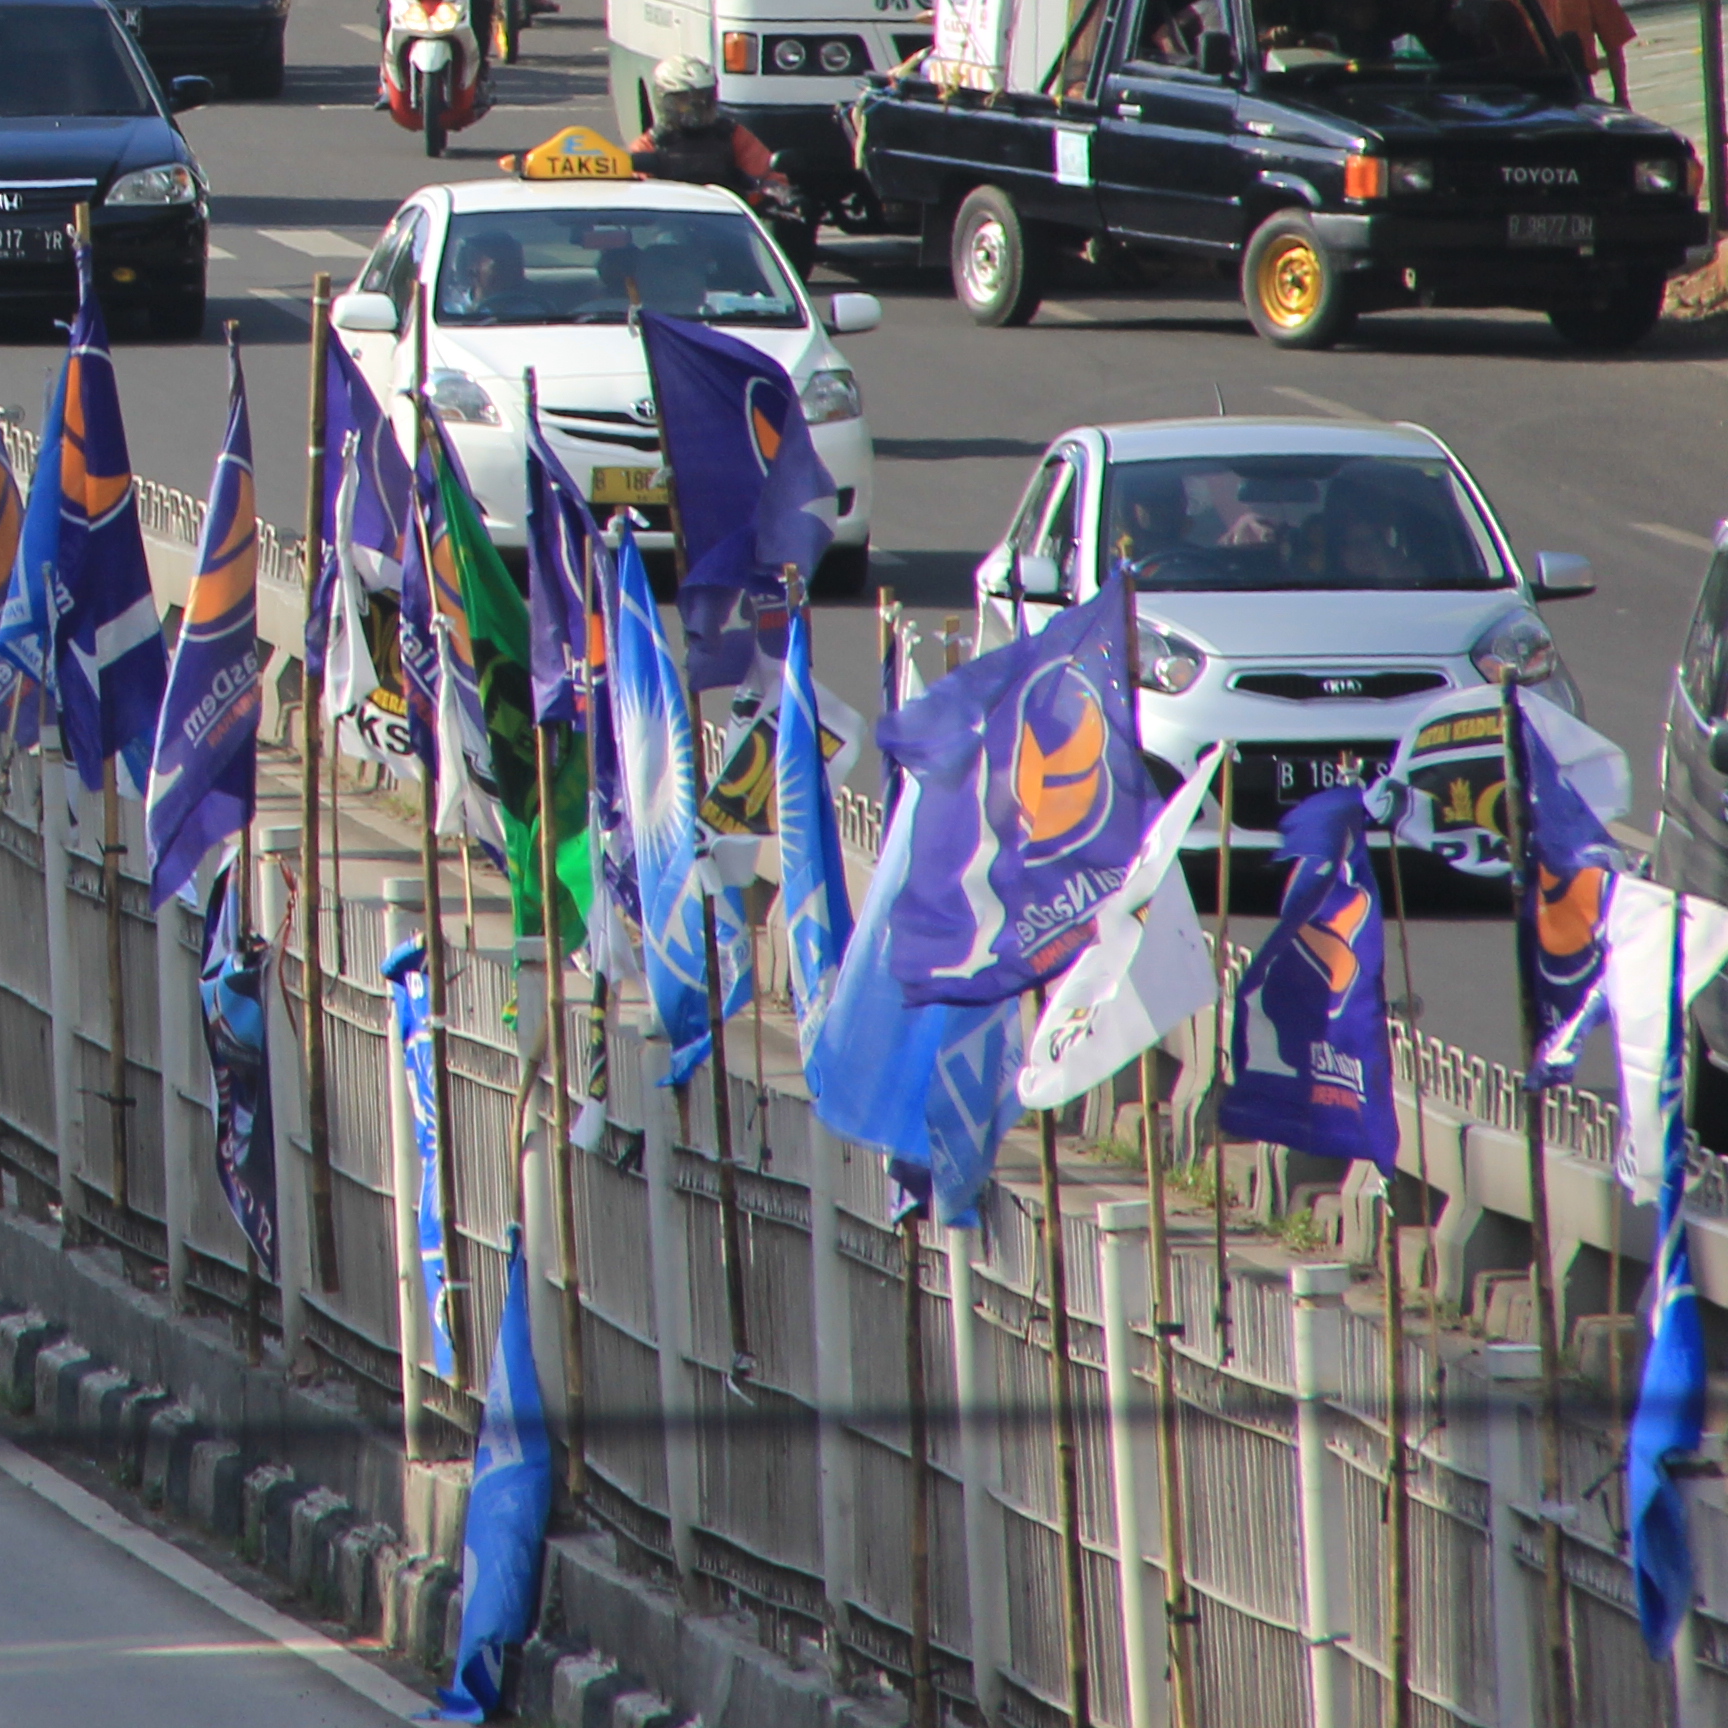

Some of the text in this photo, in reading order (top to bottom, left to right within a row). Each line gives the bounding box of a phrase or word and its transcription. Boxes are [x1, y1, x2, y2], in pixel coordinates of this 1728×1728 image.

[547, 156, 620, 176] TAKSI
[1501, 167, 1581, 184] TOYOTA
[1279, 762, 1294, 789] B
[1434, 832, 1510, 864] PK
